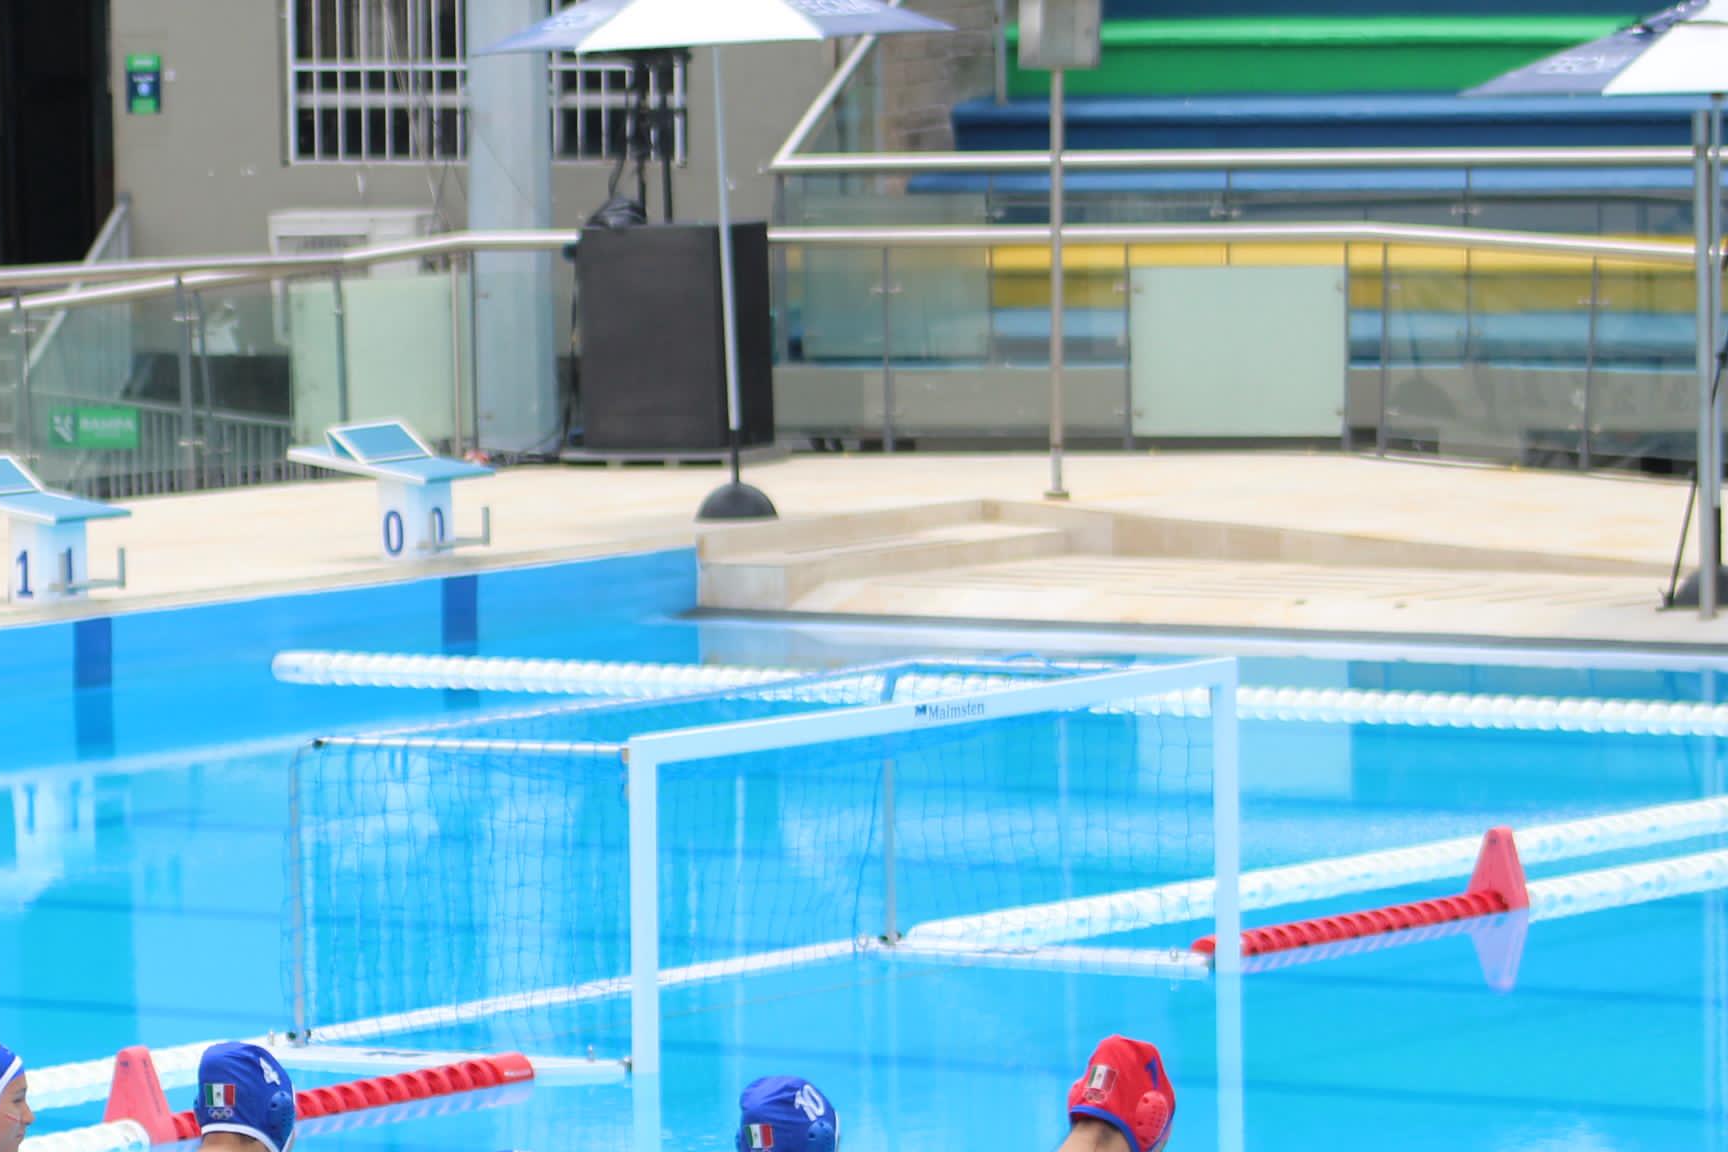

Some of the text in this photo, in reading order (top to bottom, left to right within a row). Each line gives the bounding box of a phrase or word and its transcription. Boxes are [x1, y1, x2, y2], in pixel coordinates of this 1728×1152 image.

[383, 509, 404, 558] 0
[15, 549, 34, 600] 1
[928, 702, 986, 721] Malmsten
[259, 1055, 281, 1086] 4
[792, 1082, 828, 1122] 10
